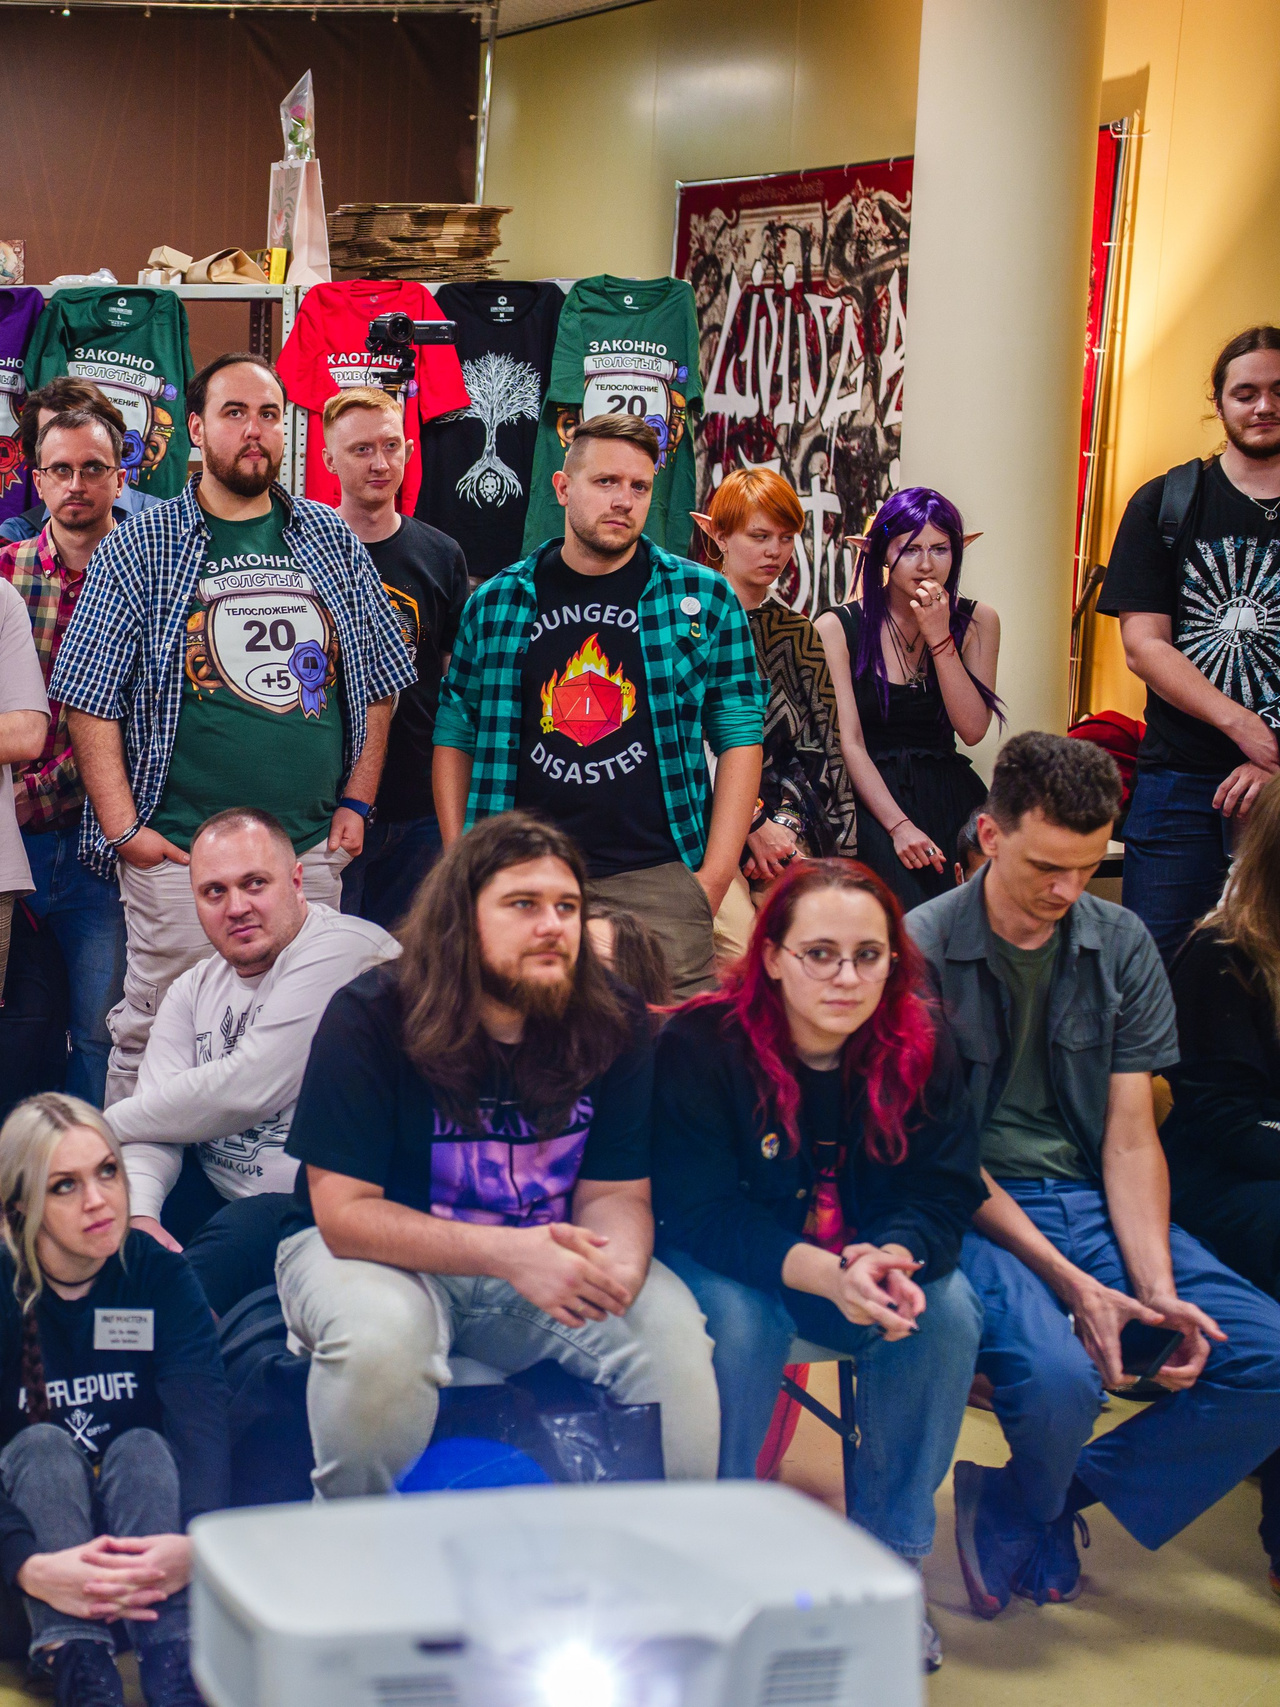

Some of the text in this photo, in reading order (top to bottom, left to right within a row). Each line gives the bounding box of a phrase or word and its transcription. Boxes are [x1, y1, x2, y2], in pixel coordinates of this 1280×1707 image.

[589, 339, 668, 356] ЗАКОННО
[74, 347, 155, 372] ЗАКОННО
[327, 352, 408, 367] ХАОТИЧН
[593, 356, 662, 372] ТОЛСТЫЙ
[76, 364, 147, 387] ТОЛСТЫЙ
[595, 383, 659, 393] ТЕЛОСЛОЖЕНИЕ
[107, 396, 140, 409] ОЖЕНИЕ
[607, 394, 648, 419] 20
[214, 572, 304, 590] ТОЛСТЫЙ
[225, 605, 308, 616] ТЕЛОСЛОЖЕНИЕ
[530, 603, 639, 642] DUNGEO
[243, 618, 297, 653] 20
[261, 670, 291, 690] +5
[530, 741, 648, 785] DISASTER
[235, 1162, 264, 1178] CLUB
[18, 1371, 138, 1414] FFLEPUFF
